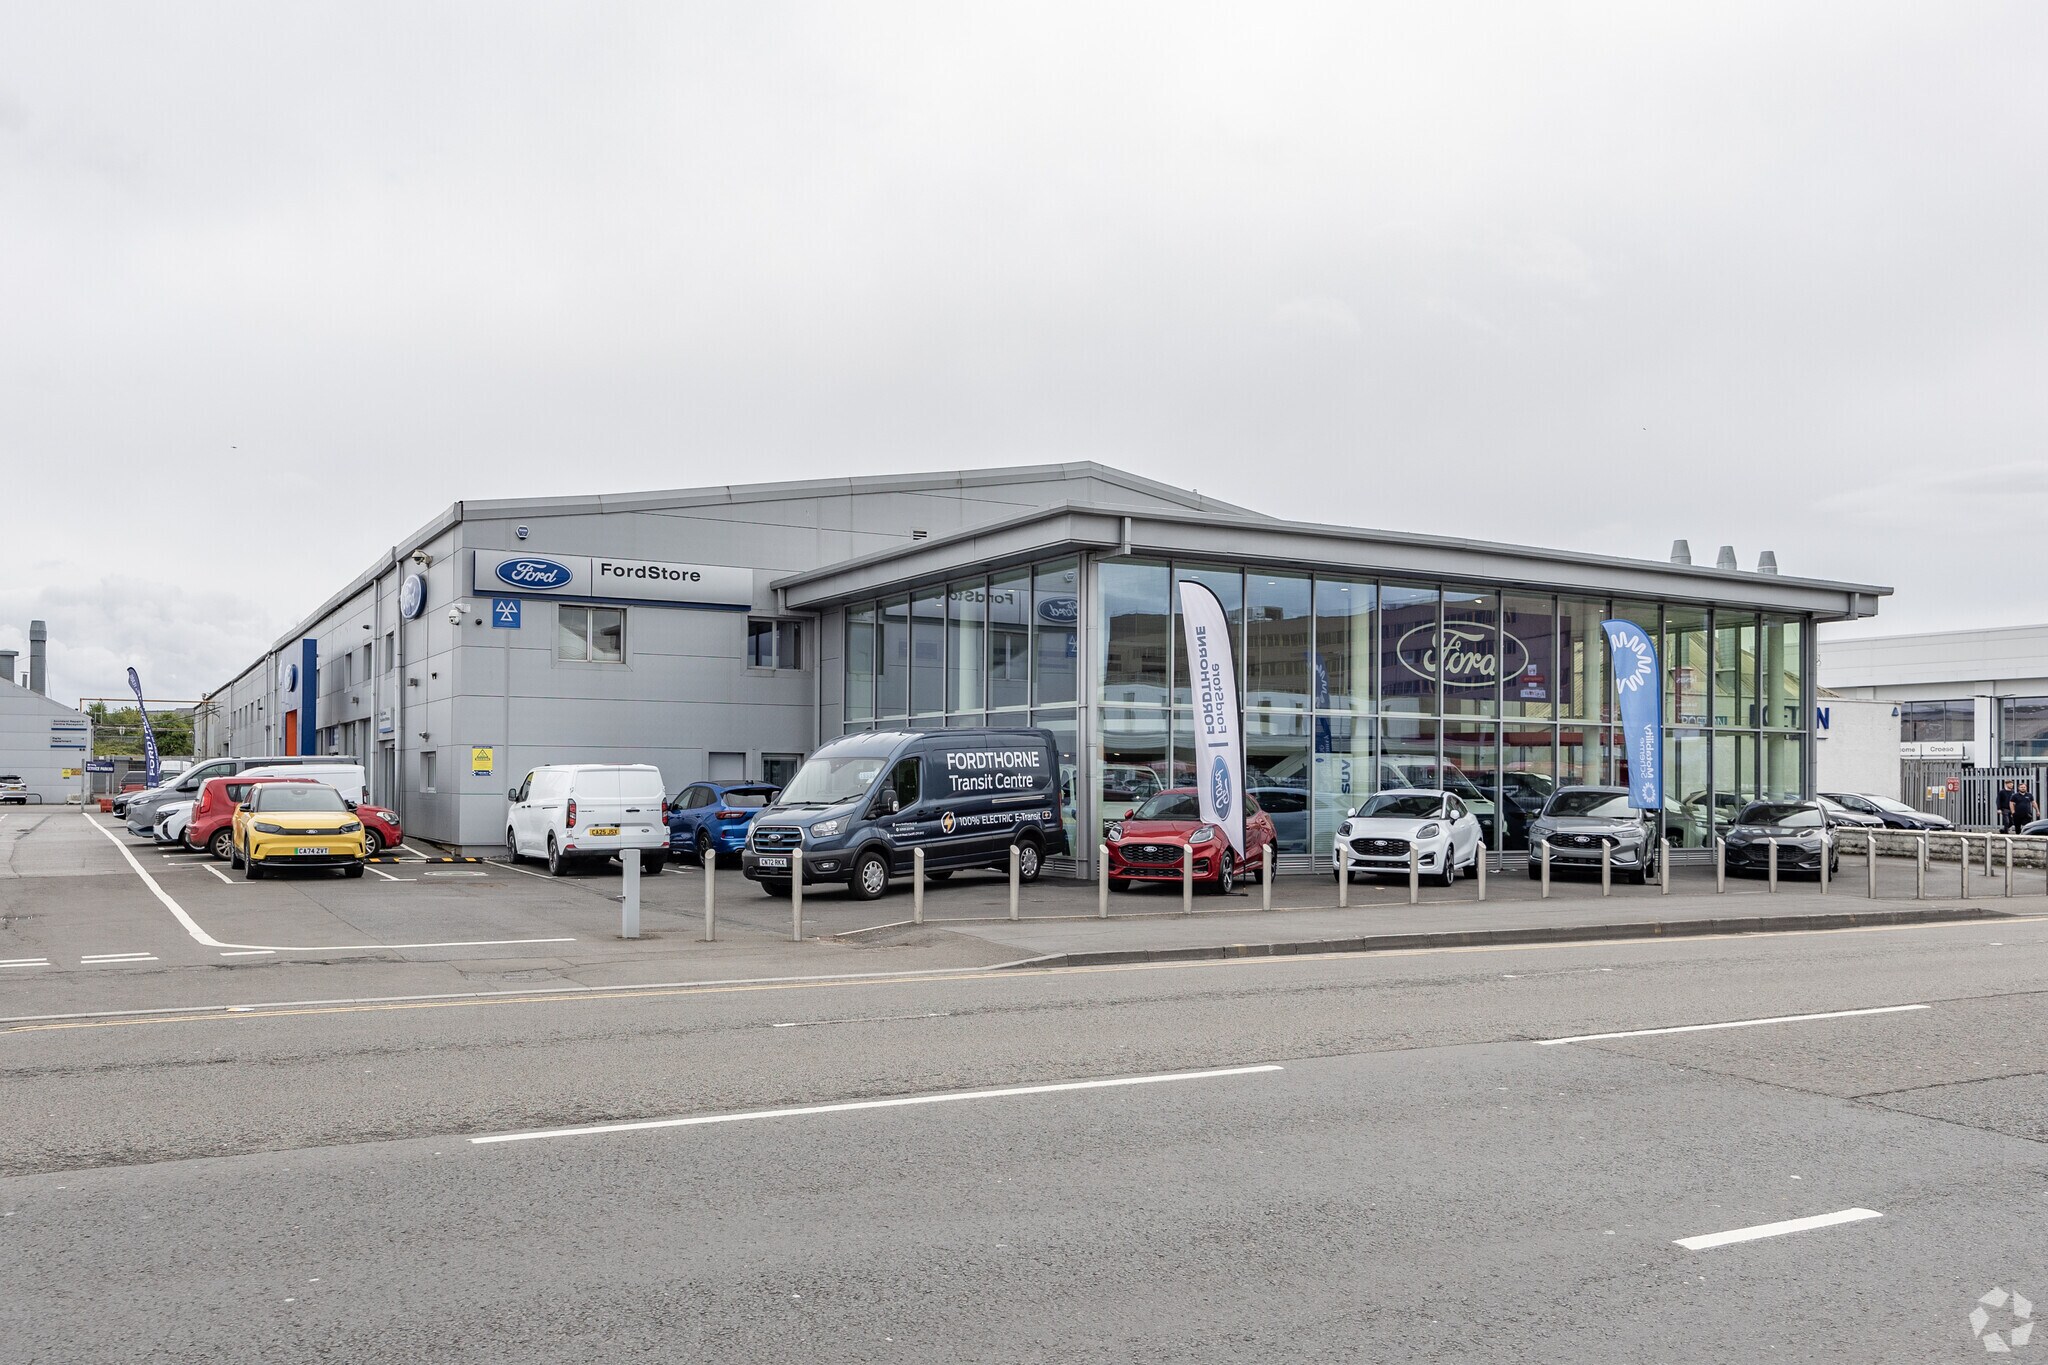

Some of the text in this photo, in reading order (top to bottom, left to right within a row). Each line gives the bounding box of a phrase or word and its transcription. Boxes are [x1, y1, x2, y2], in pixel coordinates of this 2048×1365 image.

[511, 562, 558, 583] Ford
[600, 562, 701, 583] FordStore
[946, 751, 1040, 770] FORDTHORNE
[949, 772, 1034, 791] Transit Centre
[1341, 759, 1351, 794] SUV
[959, 811, 1041, 826] 100% ELECTRIC E-Transit
